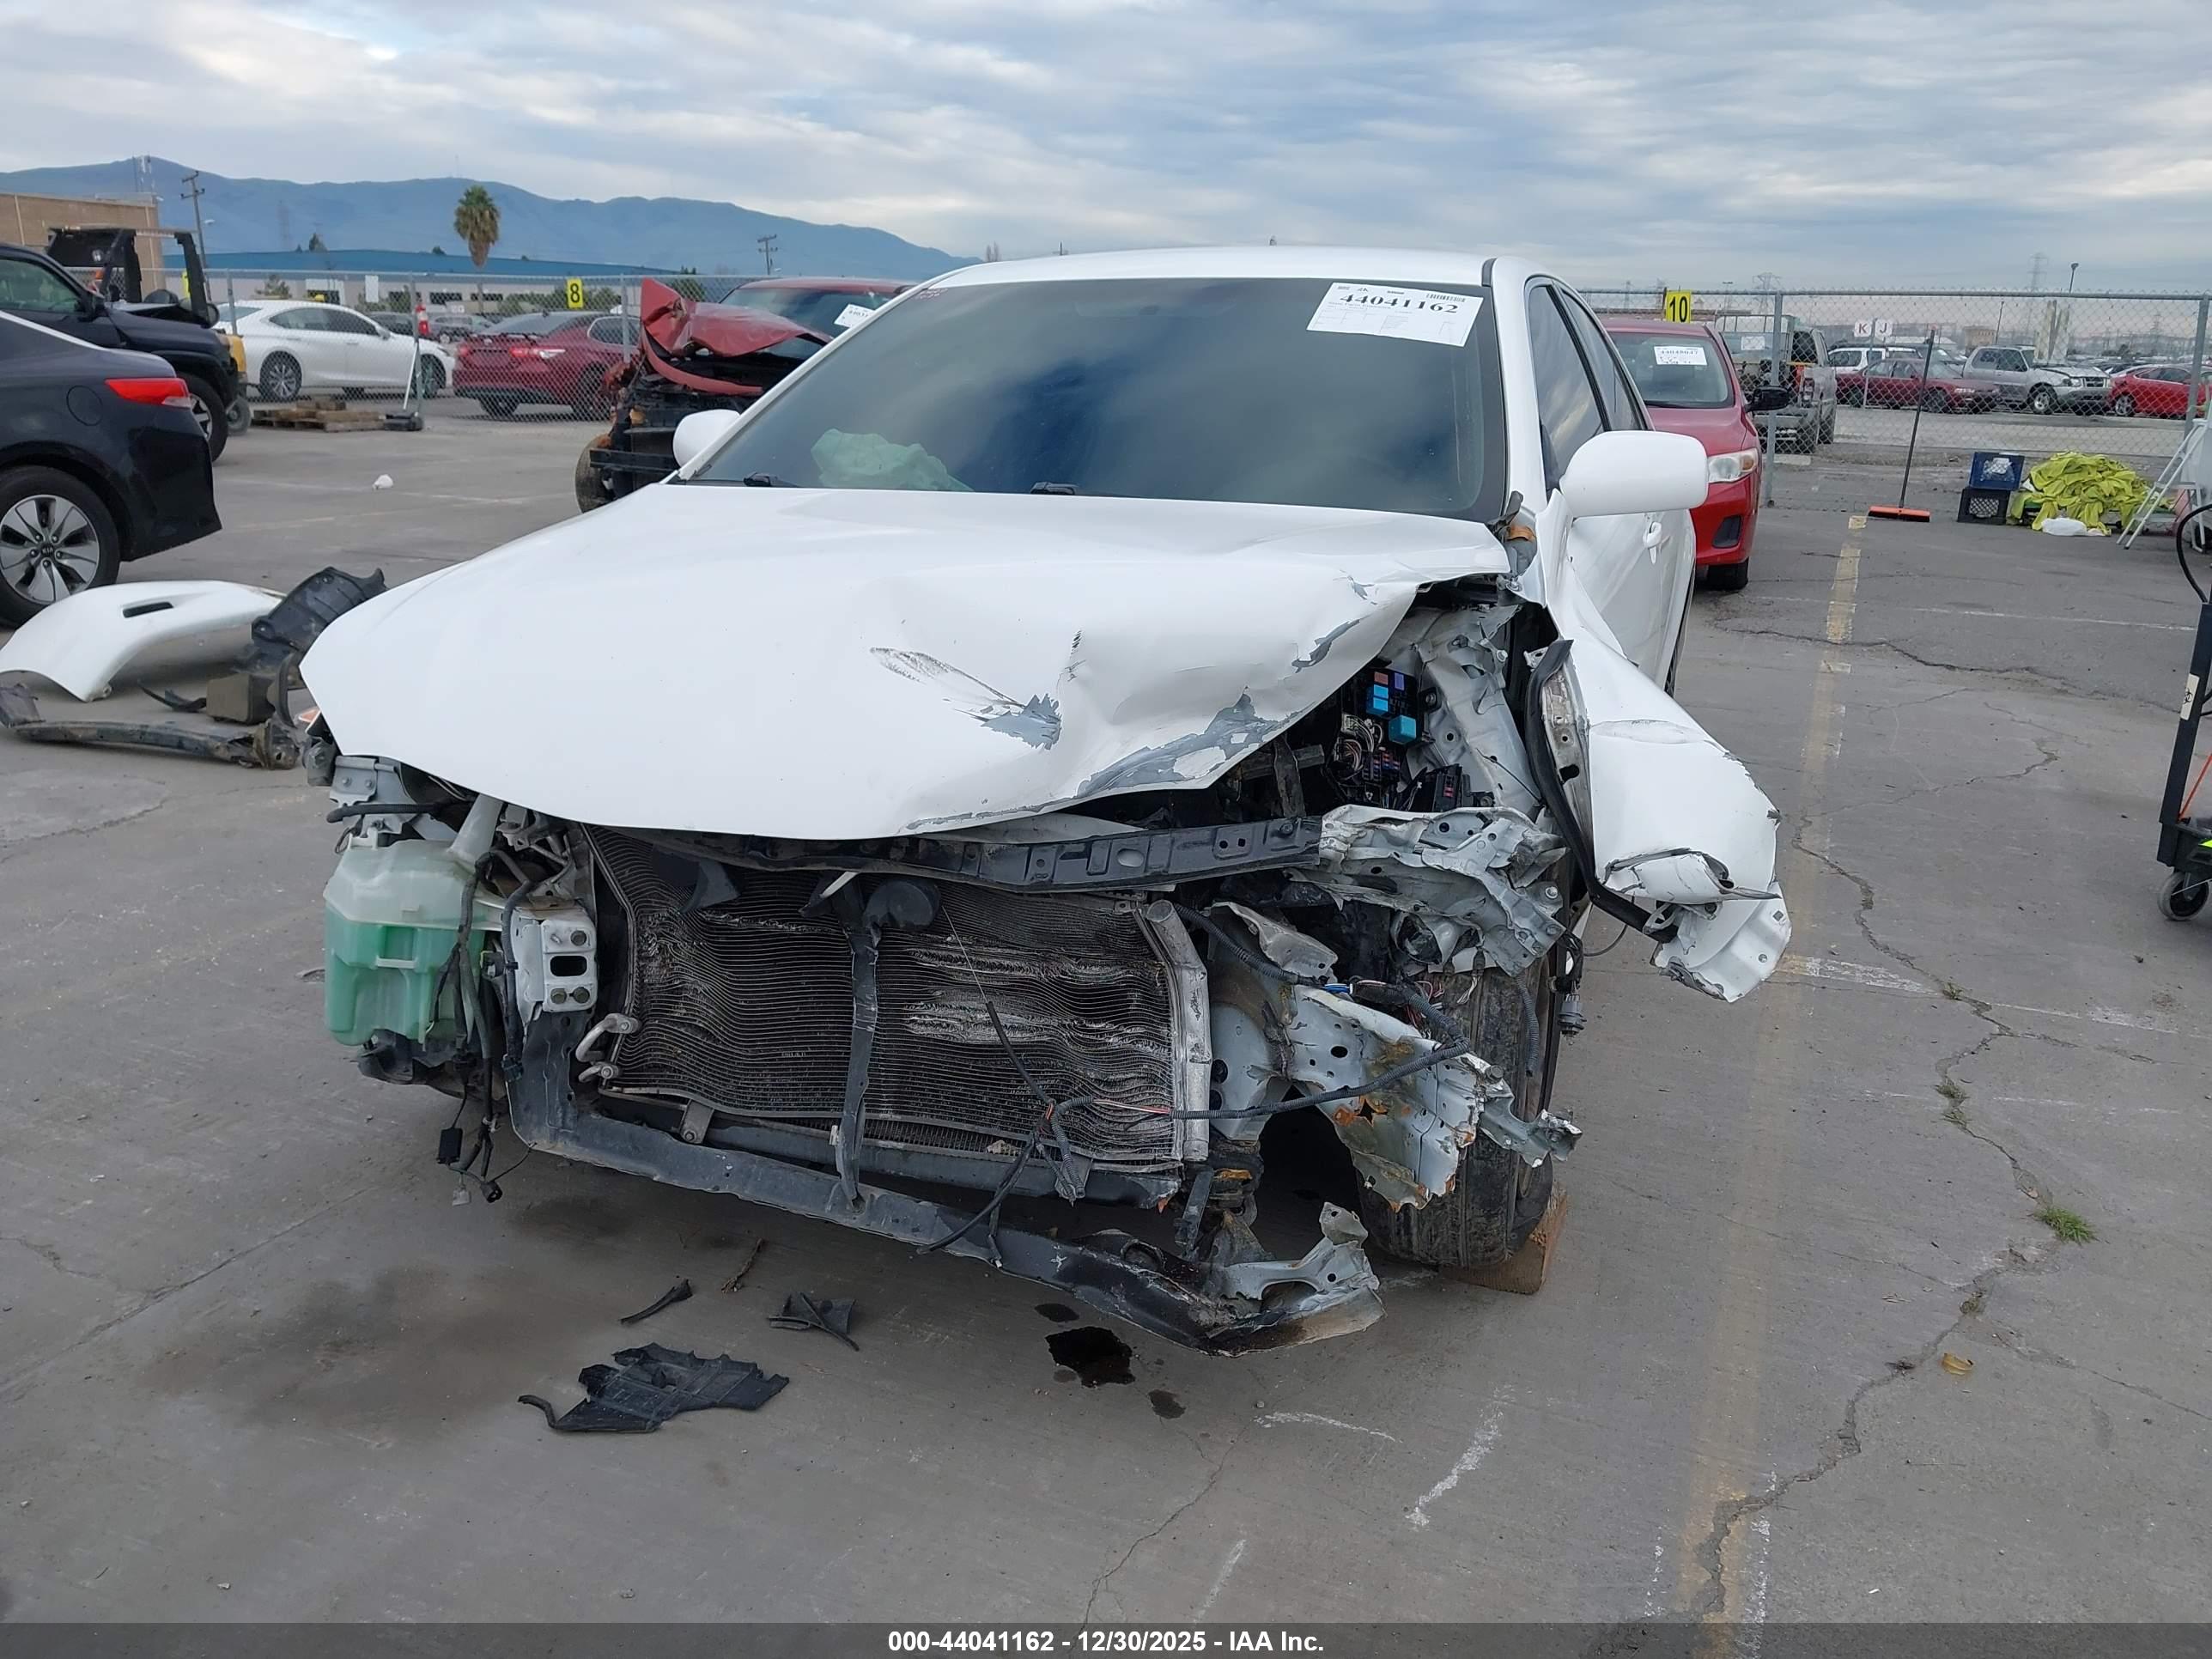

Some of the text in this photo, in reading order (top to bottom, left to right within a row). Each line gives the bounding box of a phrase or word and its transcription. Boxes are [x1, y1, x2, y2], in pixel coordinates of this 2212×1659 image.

[570, 283, 580, 303] 8
[1339, 294, 1460, 313] 44041162
[1669, 295, 1688, 323] 10
[1858, 323, 1868, 334] K
[1879, 322, 1887, 334] J
